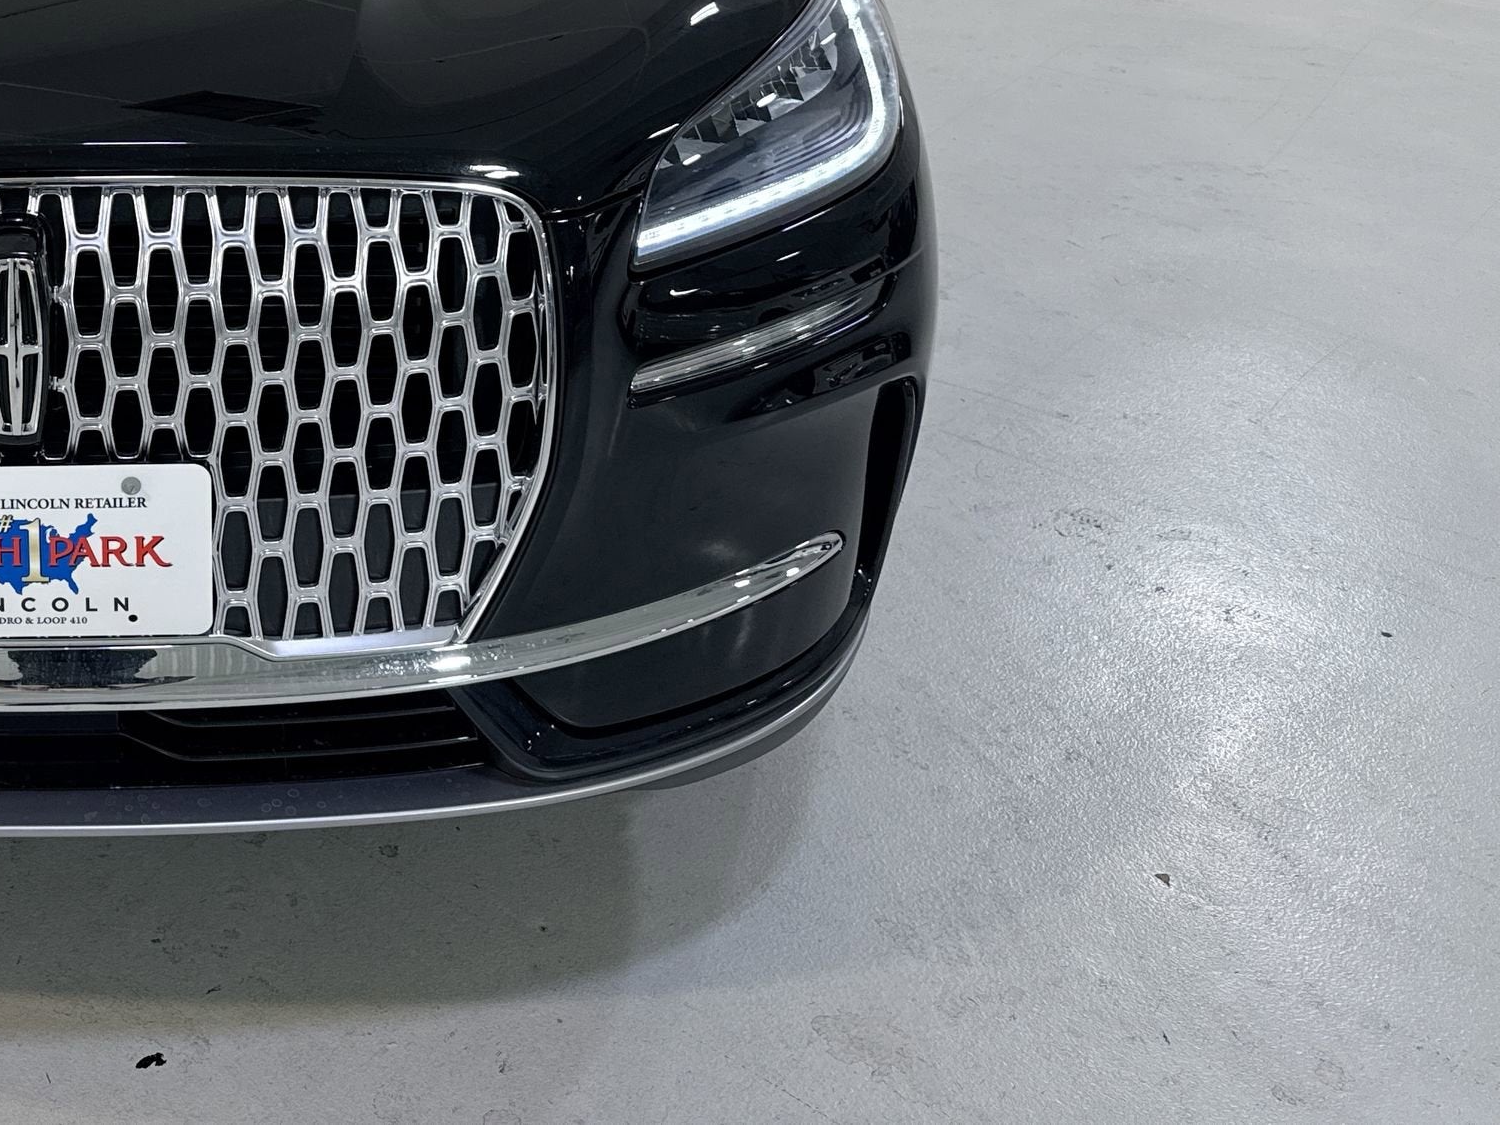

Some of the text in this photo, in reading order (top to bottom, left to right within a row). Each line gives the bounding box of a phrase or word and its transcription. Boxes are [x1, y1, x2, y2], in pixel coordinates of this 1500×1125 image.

[1, 498, 70, 510] LINCOLN
[74, 497, 147, 509] RETAILER
[48, 535, 173, 568] PARK
[25, 616, 36, 625] &
[37, 616, 67, 625] LOOP
[69, 616, 88, 625] 410
